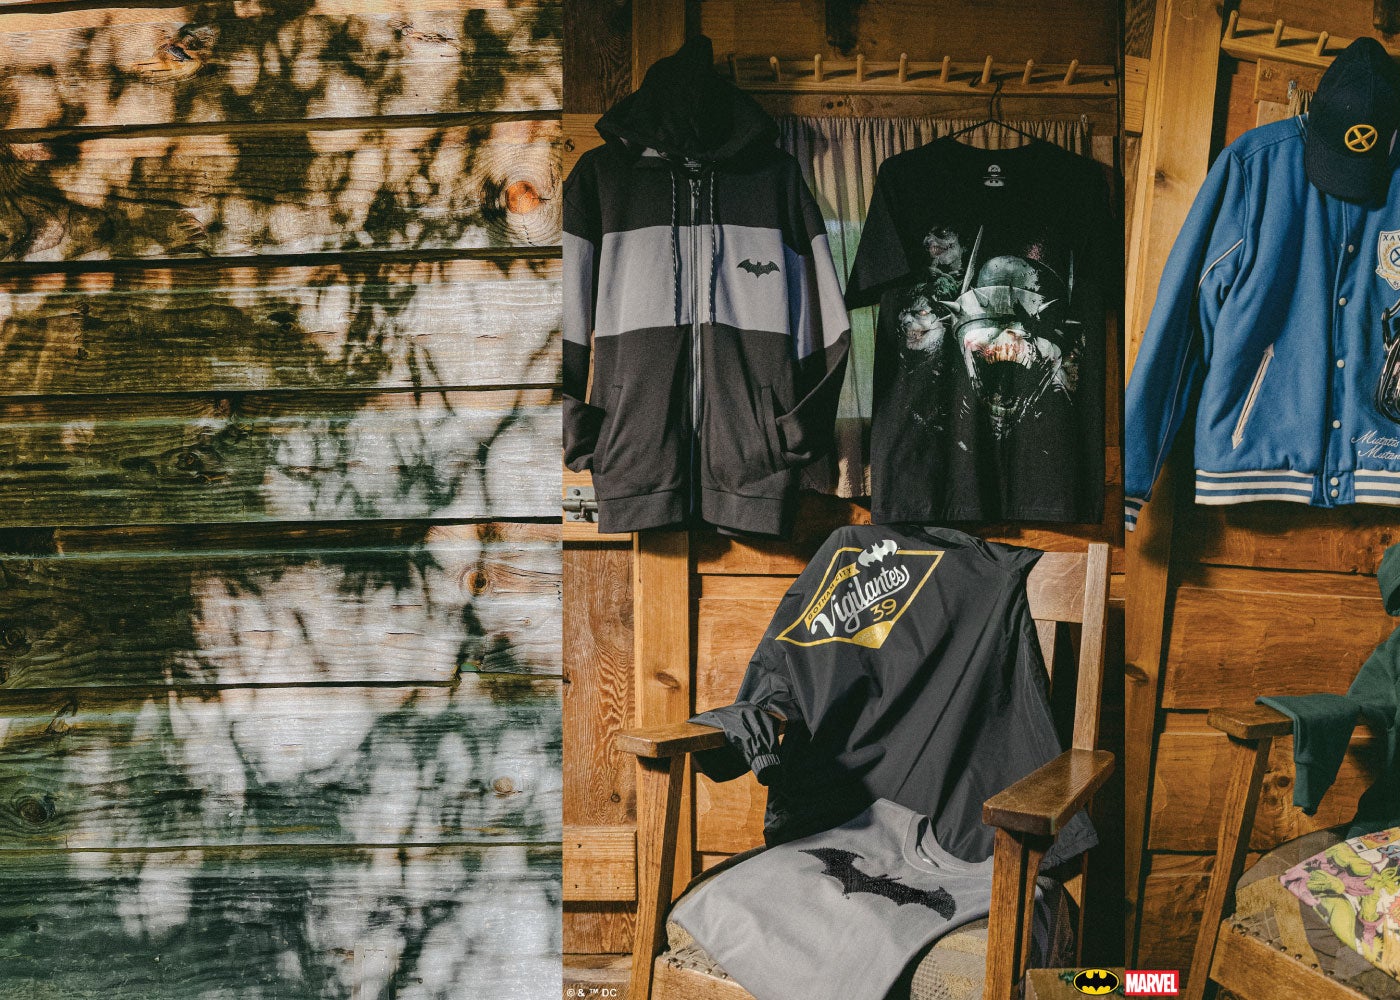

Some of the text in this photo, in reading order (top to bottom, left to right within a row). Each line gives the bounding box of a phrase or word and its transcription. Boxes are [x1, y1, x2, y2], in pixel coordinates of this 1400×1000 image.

[1351, 430, 1400, 448] Mutatis
[808, 568, 851, 620] GOTHAM CITY
[811, 565, 910, 637] Vigilantes
[870, 598, 897, 622] 39
